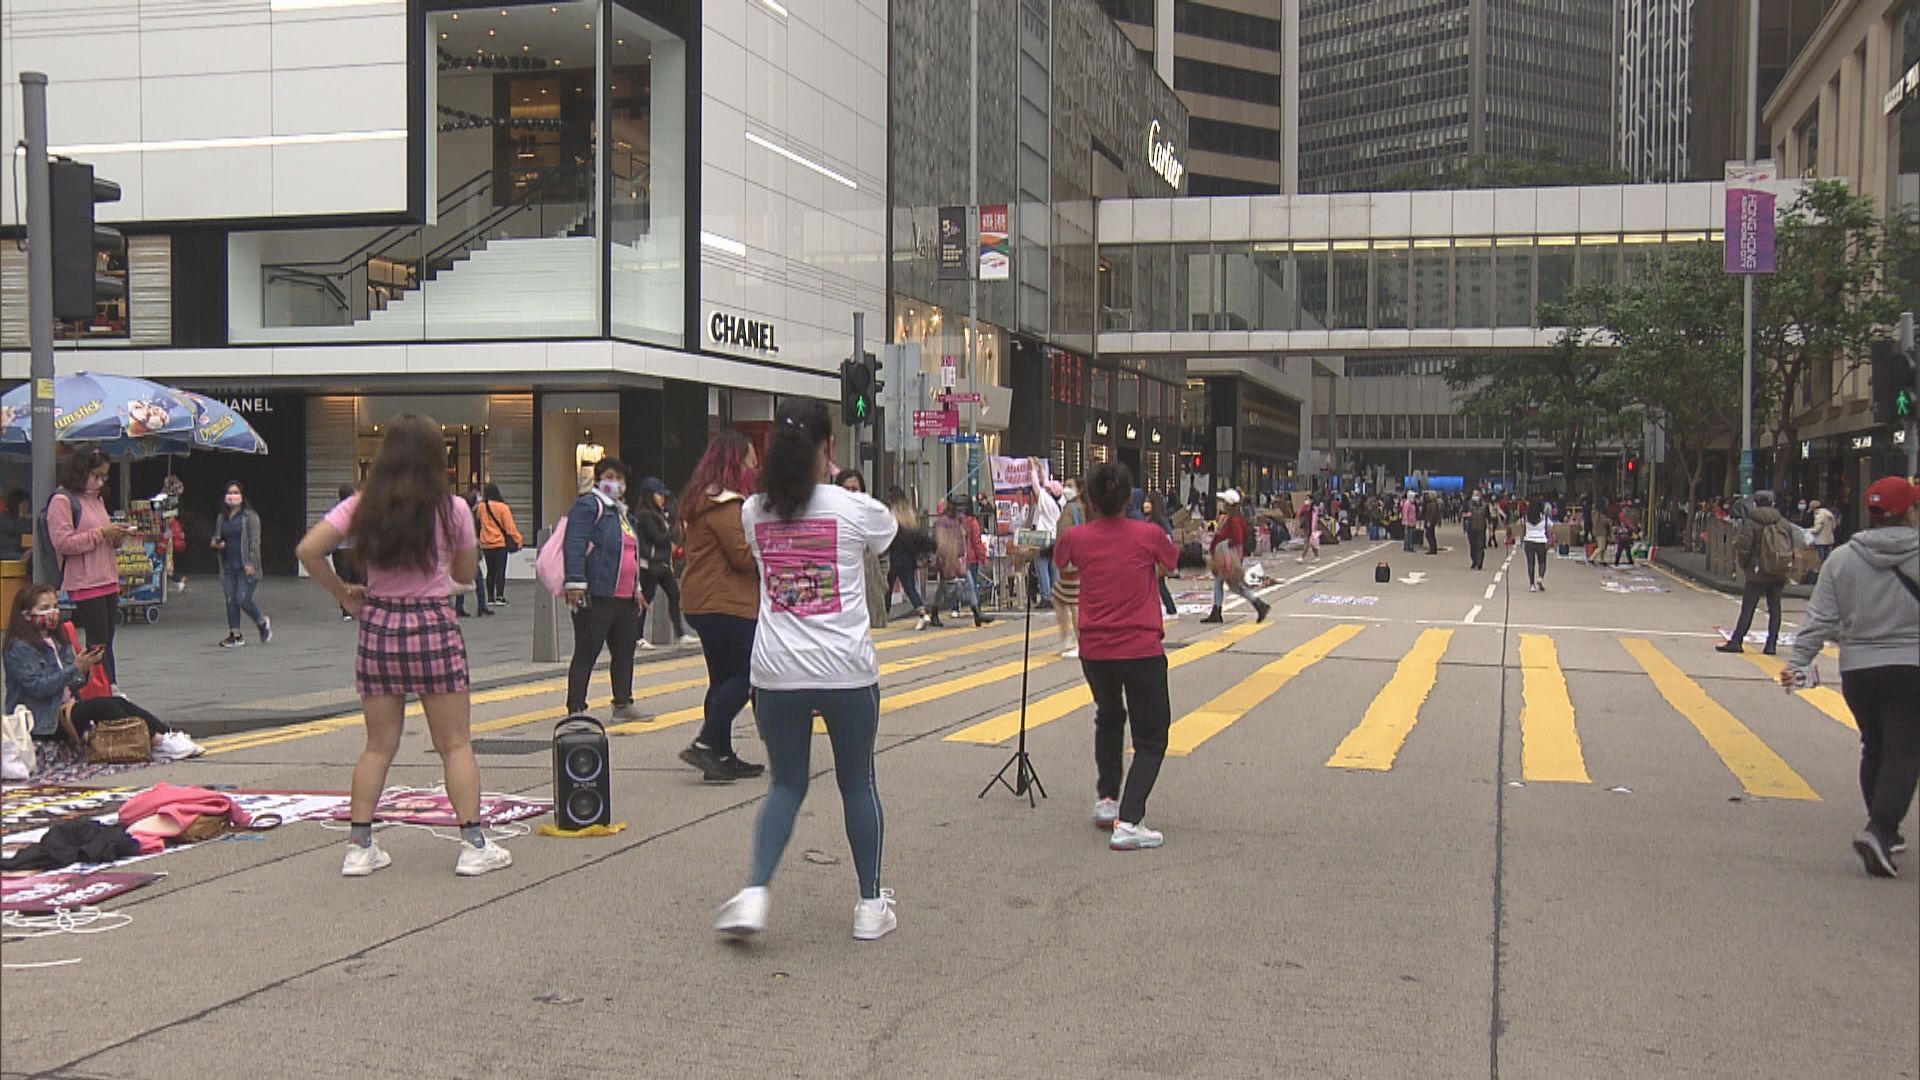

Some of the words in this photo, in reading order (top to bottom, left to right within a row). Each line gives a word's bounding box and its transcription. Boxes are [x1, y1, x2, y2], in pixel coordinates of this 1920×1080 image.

[1148, 119, 1184, 190] Cartier
[1747, 194, 1757, 232] HONG
[1746, 233, 1757, 269] KONG
[709, 311, 779, 352] CHANEL
